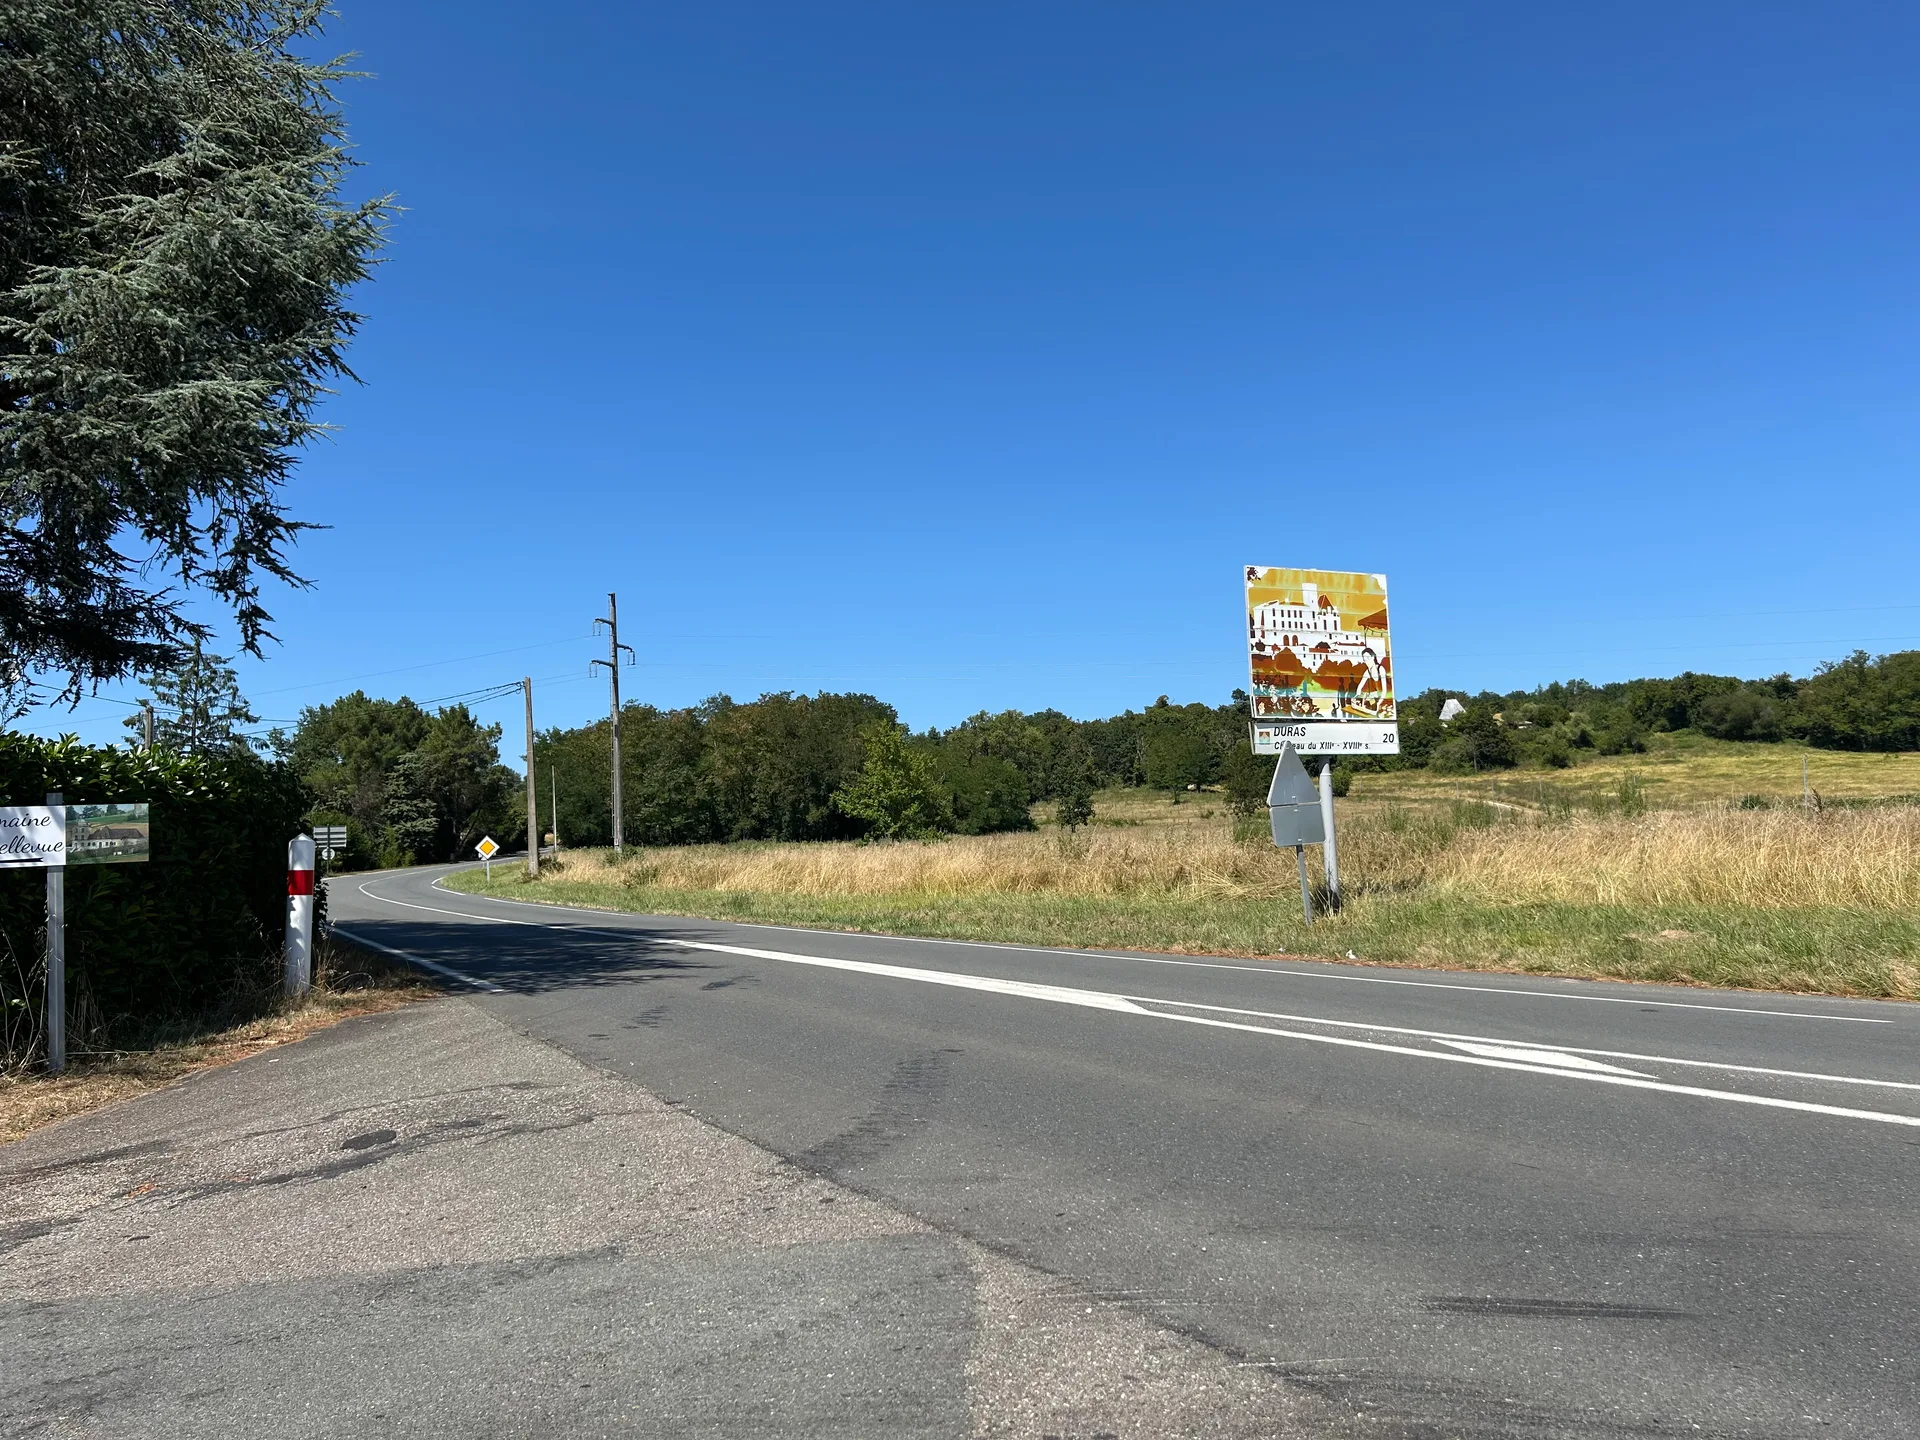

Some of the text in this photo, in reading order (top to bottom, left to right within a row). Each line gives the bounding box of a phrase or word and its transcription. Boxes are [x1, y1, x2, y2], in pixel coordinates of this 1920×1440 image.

[1273, 726, 1306, 737] DURAS
[1382, 733, 1395, 743] 20
[1307, 741, 1317, 750] du
